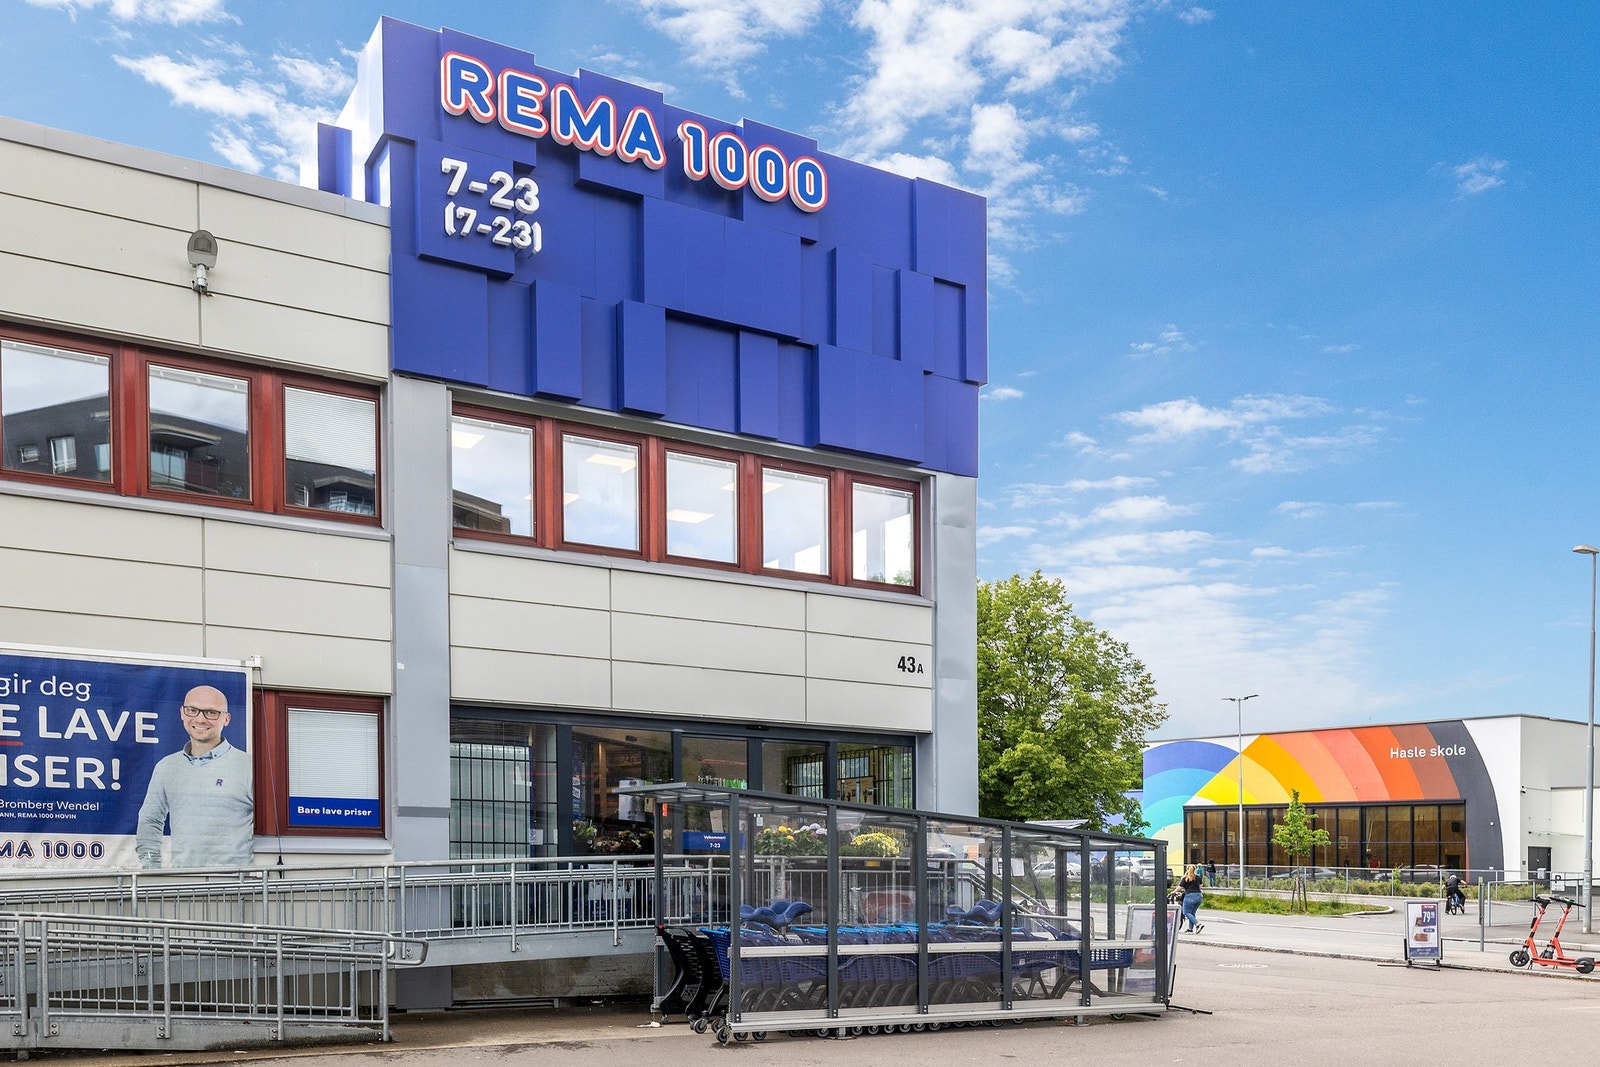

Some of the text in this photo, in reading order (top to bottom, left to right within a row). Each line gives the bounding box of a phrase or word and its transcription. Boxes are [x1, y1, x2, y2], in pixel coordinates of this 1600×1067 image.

[441, 51, 828, 213] REMA 1000
[441, 157, 540, 214] 7-23
[443, 201, 542, 254] (7-23)
[40, 675, 91, 702] deg
[38, 705, 160, 744] LAVE
[1390, 744, 1467, 759] Hasle skole
[215, 778, 223, 787] R
[56, 800, 100, 811] Wendel
[297, 806, 372, 817] Bare lave priser
[41, 839, 105, 860] 1000
